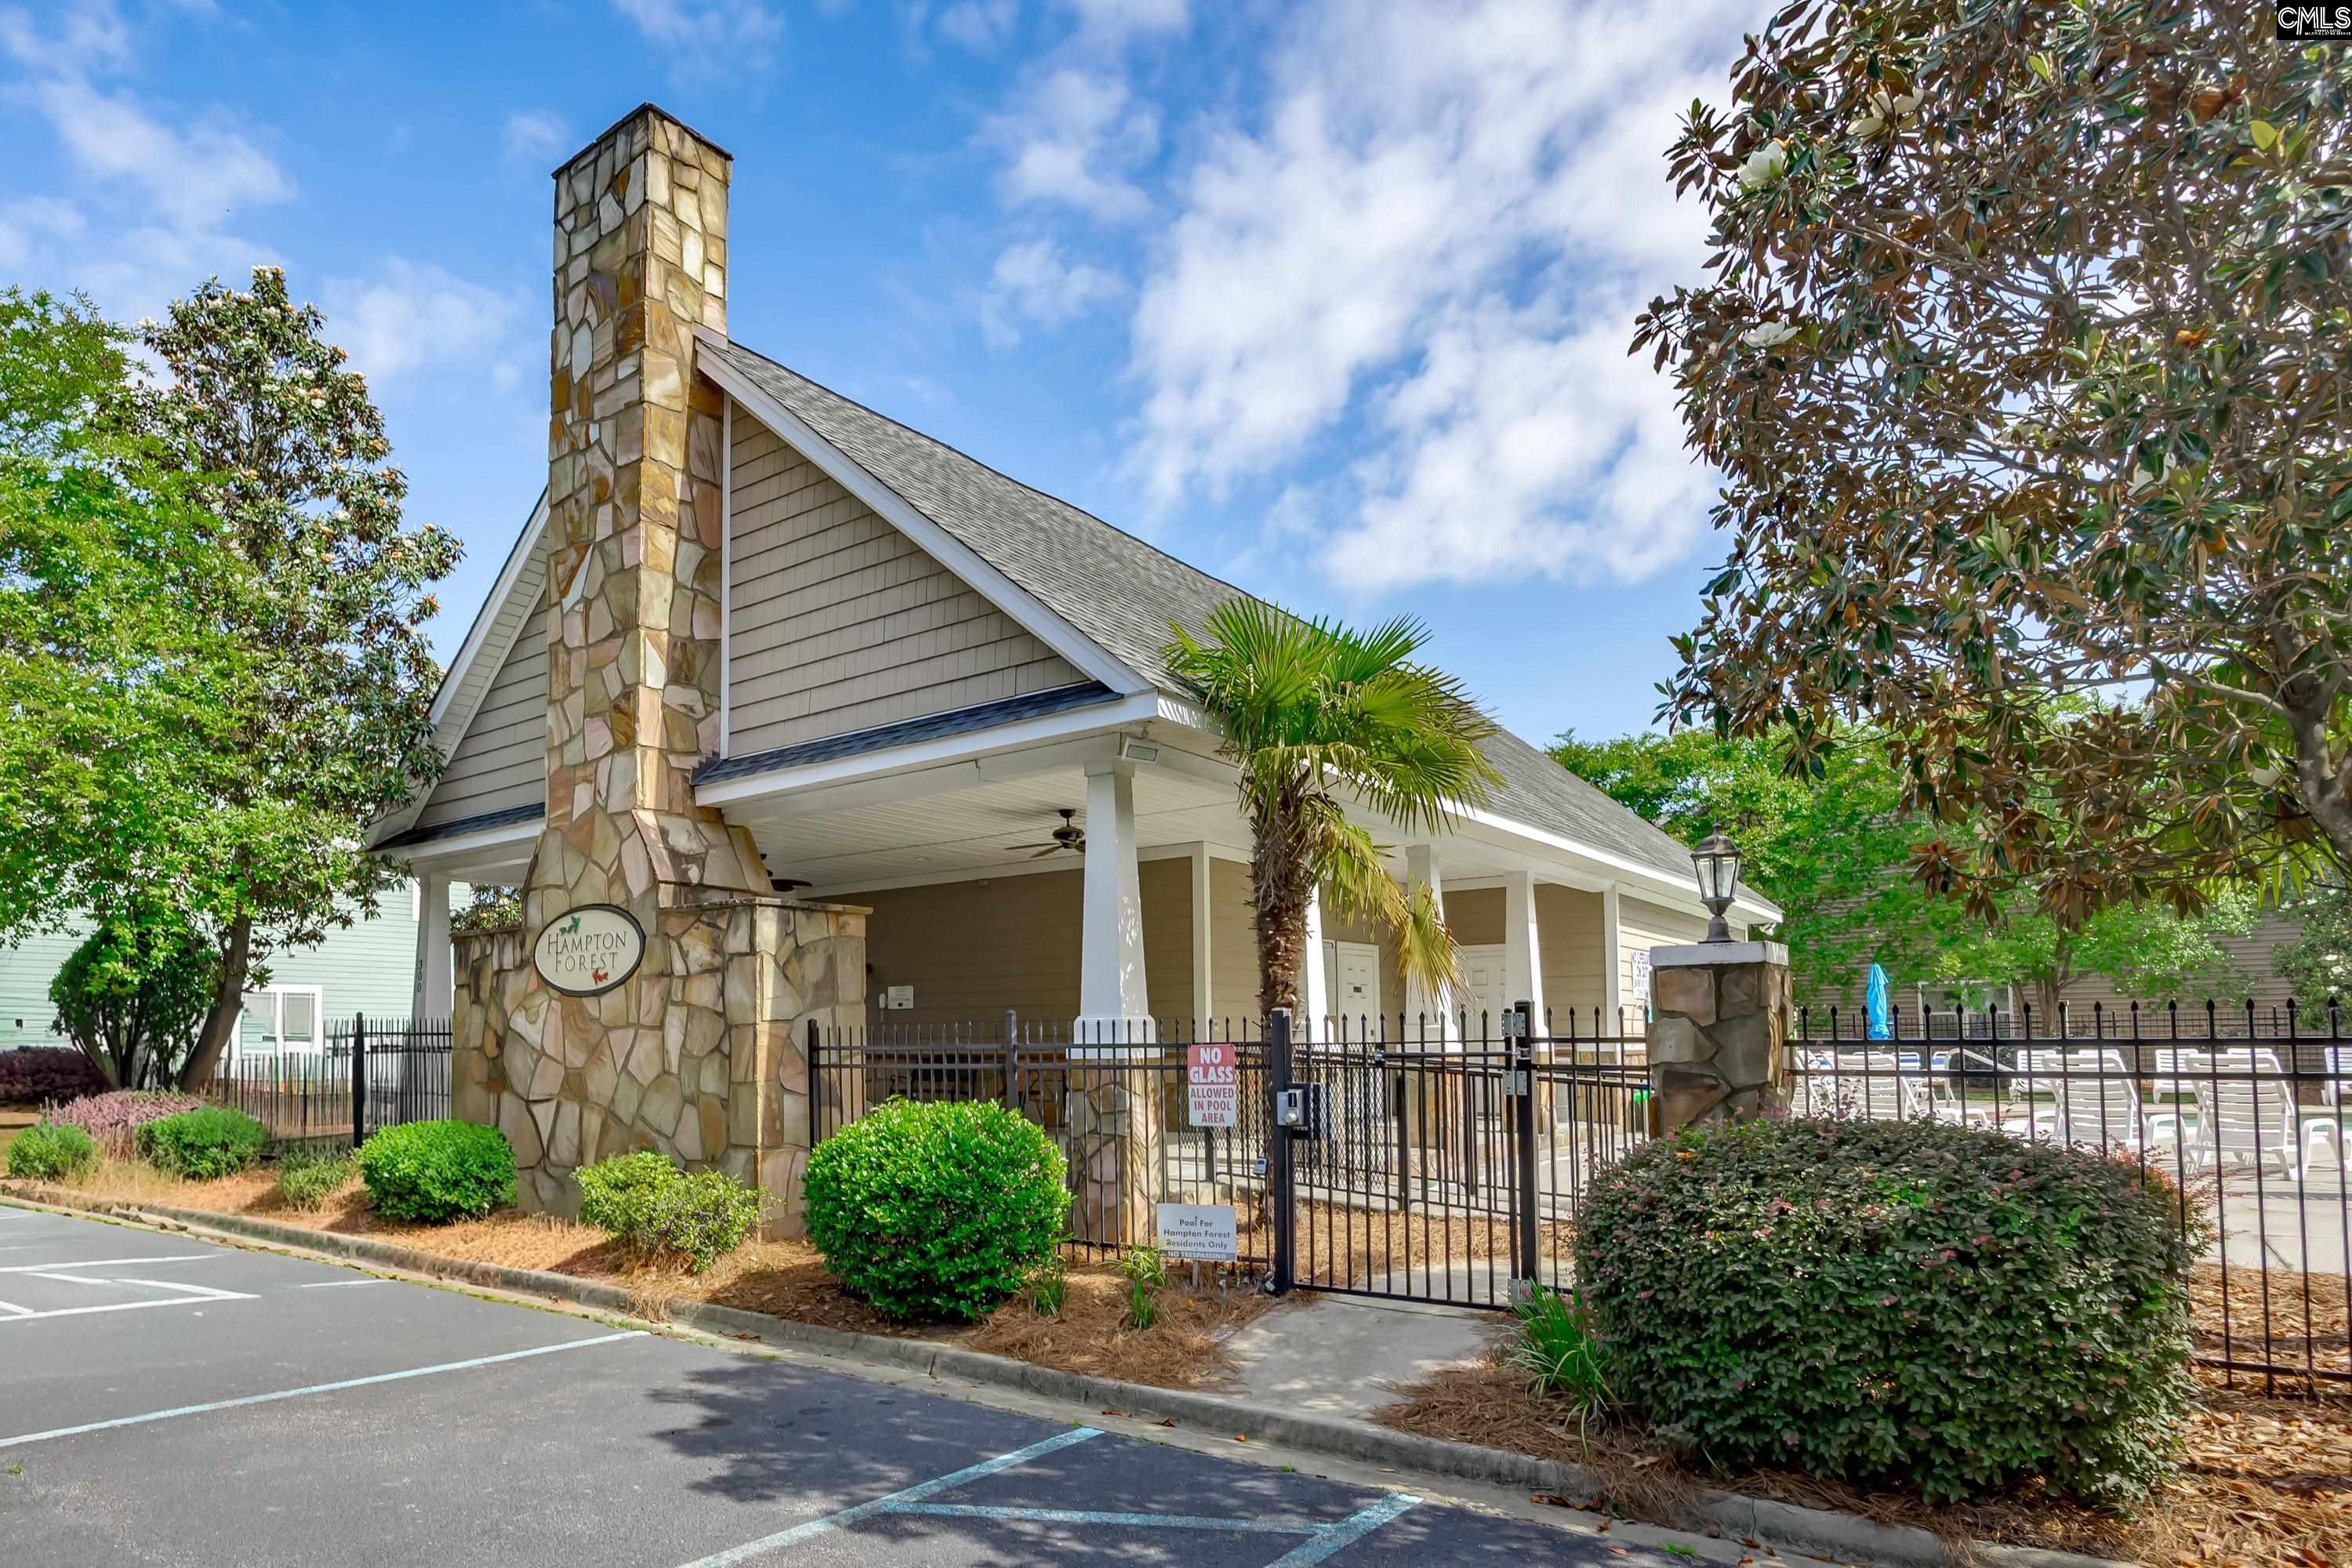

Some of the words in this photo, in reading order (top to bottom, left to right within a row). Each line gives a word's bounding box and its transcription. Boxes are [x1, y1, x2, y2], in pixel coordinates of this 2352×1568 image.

[547, 931, 626, 953] HAMPTON
[556, 952, 618, 972] FOREST
[1200, 1047, 1221, 1064] NO
[1189, 1066, 1234, 1083] GLASS
[1191, 1087, 1234, 1098] ALLOWED
[1194, 1101, 1203, 1110] IN
[1207, 1101, 1232, 1110] POOL
[1201, 1113, 1225, 1123] AREA
[1179, 1218, 1197, 1227] Pool
[1163, 1229, 1202, 1238] Hampton
[1208, 1241, 1228, 1250] Only
